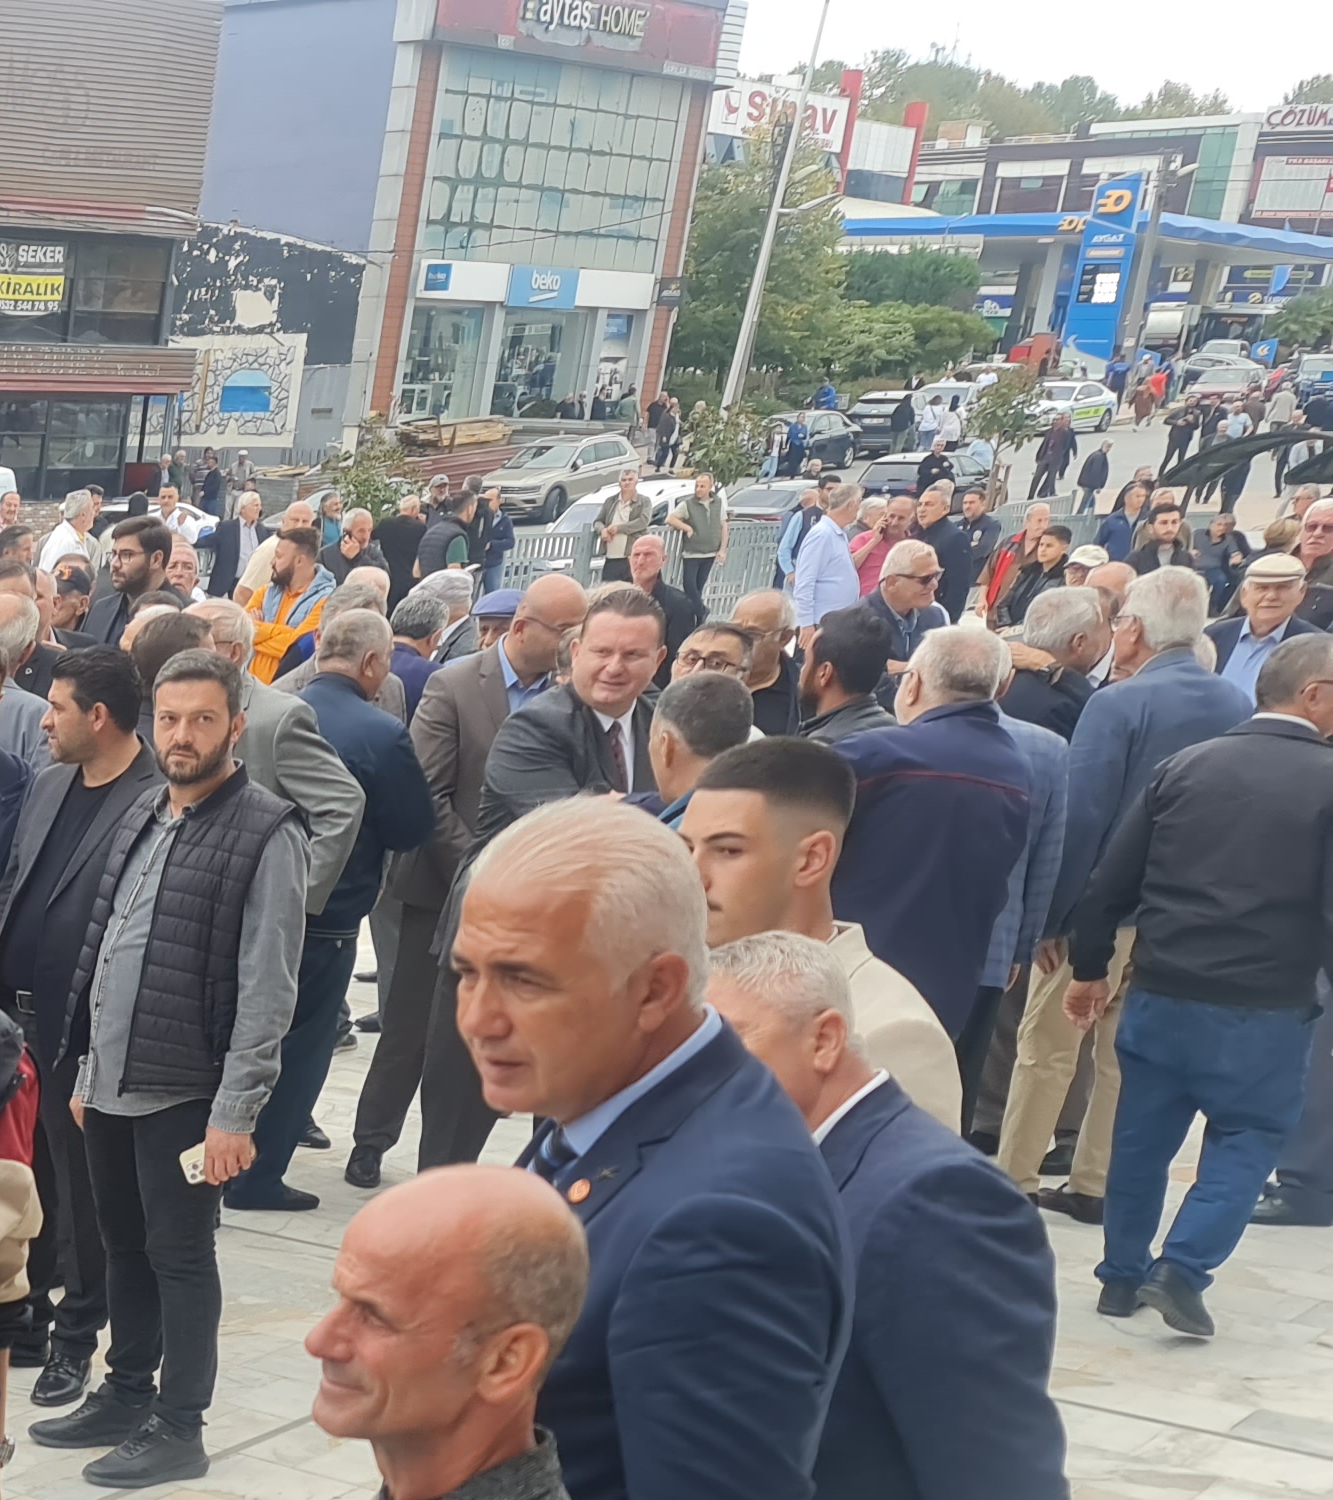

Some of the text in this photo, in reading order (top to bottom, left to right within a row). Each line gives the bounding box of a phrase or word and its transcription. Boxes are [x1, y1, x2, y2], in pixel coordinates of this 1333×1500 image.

[599, 5, 645, 36] HOME
[1267, 106, 1330, 129] ÇÖZÜM
[18, 245, 64, 266] ŞEKER
[532, 270, 561, 291] beko
[34, 302, 45, 311] 74
[47, 301, 59, 311] 95
